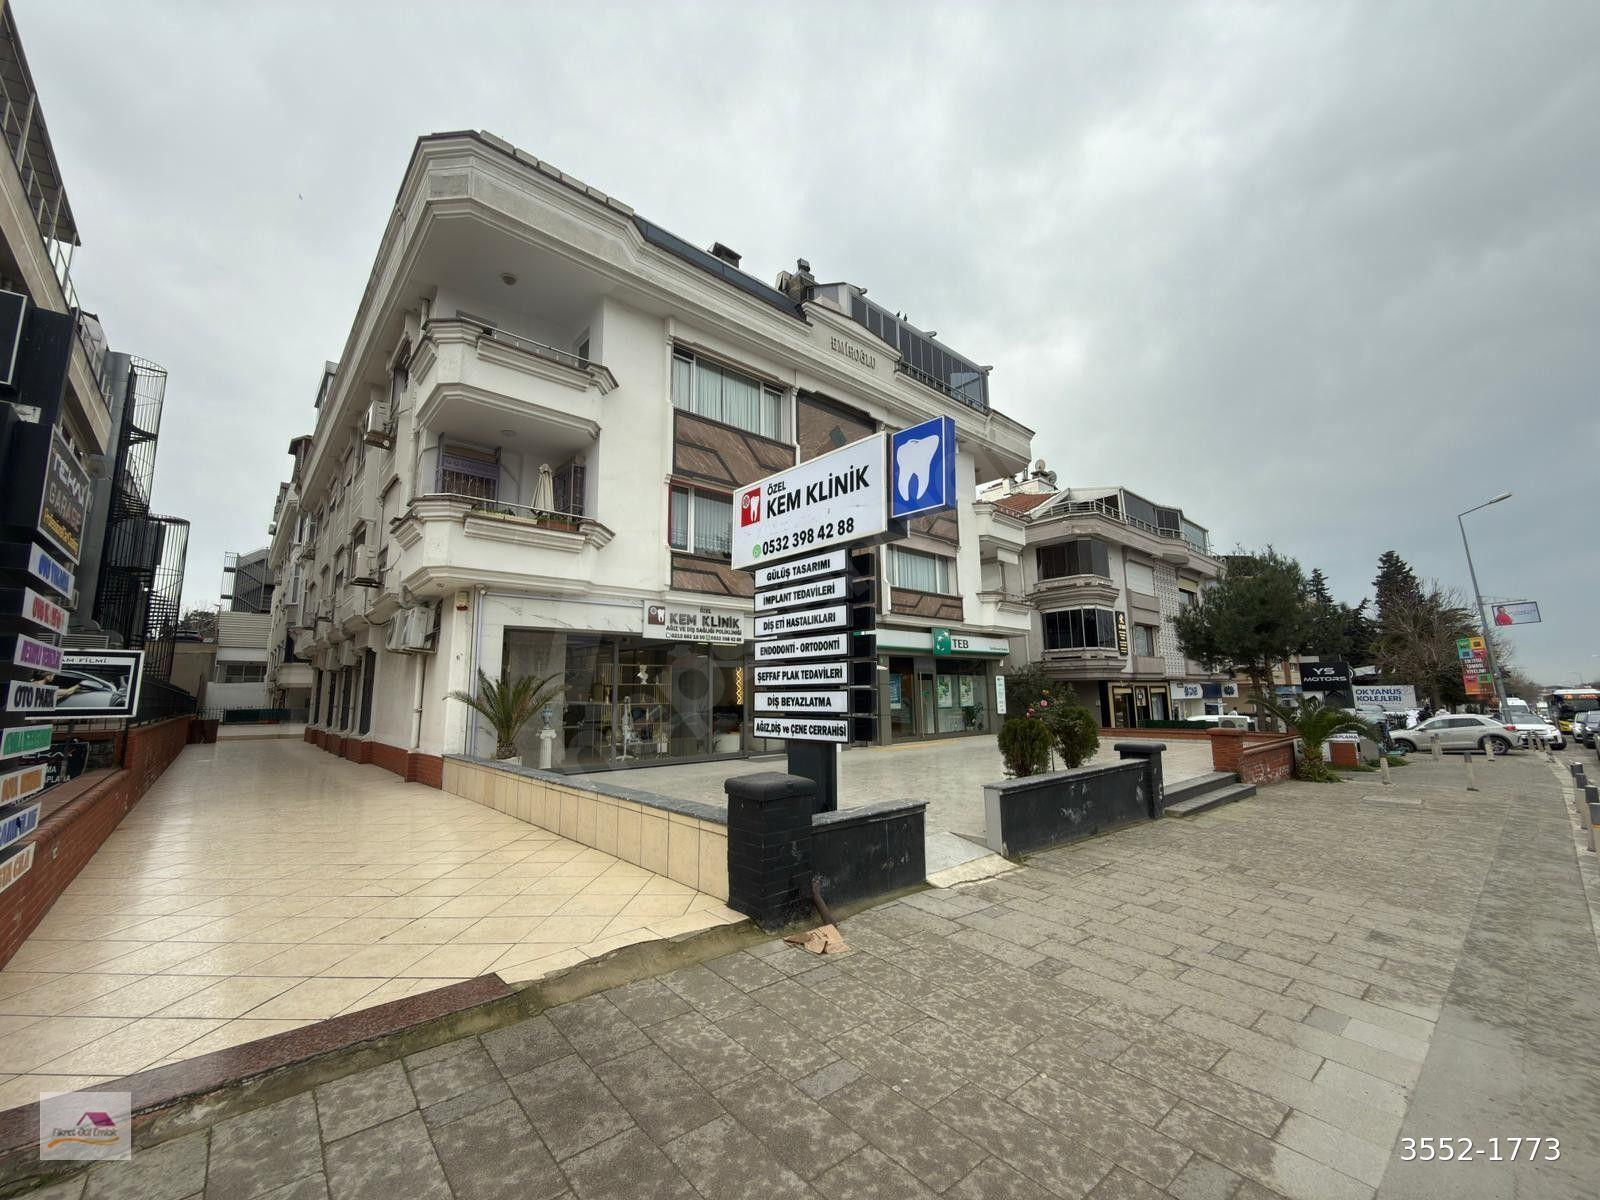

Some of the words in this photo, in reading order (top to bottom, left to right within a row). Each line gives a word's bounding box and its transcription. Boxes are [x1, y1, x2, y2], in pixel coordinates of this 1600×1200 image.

[767, 481, 787, 496] ÖZEL
[767, 489, 801, 519] KEM
[806, 465, 870, 506] KLİNİK
[762, 535, 790, 556] 0532
[792, 529, 815, 548] 398
[817, 523, 834, 542] 42
[837, 517, 855, 536] 88
[766, 567, 791, 582] GÜLÜŞ
[792, 559, 831, 576] TASARIMI
[763, 592, 792, 606] İMPLANT
[793, 582, 835, 603] TEDAVİLERİ
[669, 613, 697, 626] KEM
[702, 615, 740, 629] KLİNİK
[763, 617, 774, 632] DİŞ
[775, 616, 785, 629] ETİ
[786, 612, 836, 627] HASTALIKLARI
[760, 642, 795, 656] ENDODONTİ
[800, 637, 840, 652] ORTODONTİ
[952, 638, 969, 649] TEB
[757, 671, 780, 684] ŞEFFAF
[782, 670, 800, 681] PLAK
[801, 666, 843, 680] TEDAVİLERİ
[1312, 667, 1336, 675] YS
[14, 685, 34, 708] OTO
[1355, 688, 1402, 696] OKYANUS
[767, 694, 779, 709] DİŞ
[781, 696, 832, 707] BEYAZLATMA
[791, 725, 808, 737] ÇENE
[808, 723, 847, 737] CERRAHİSİ
